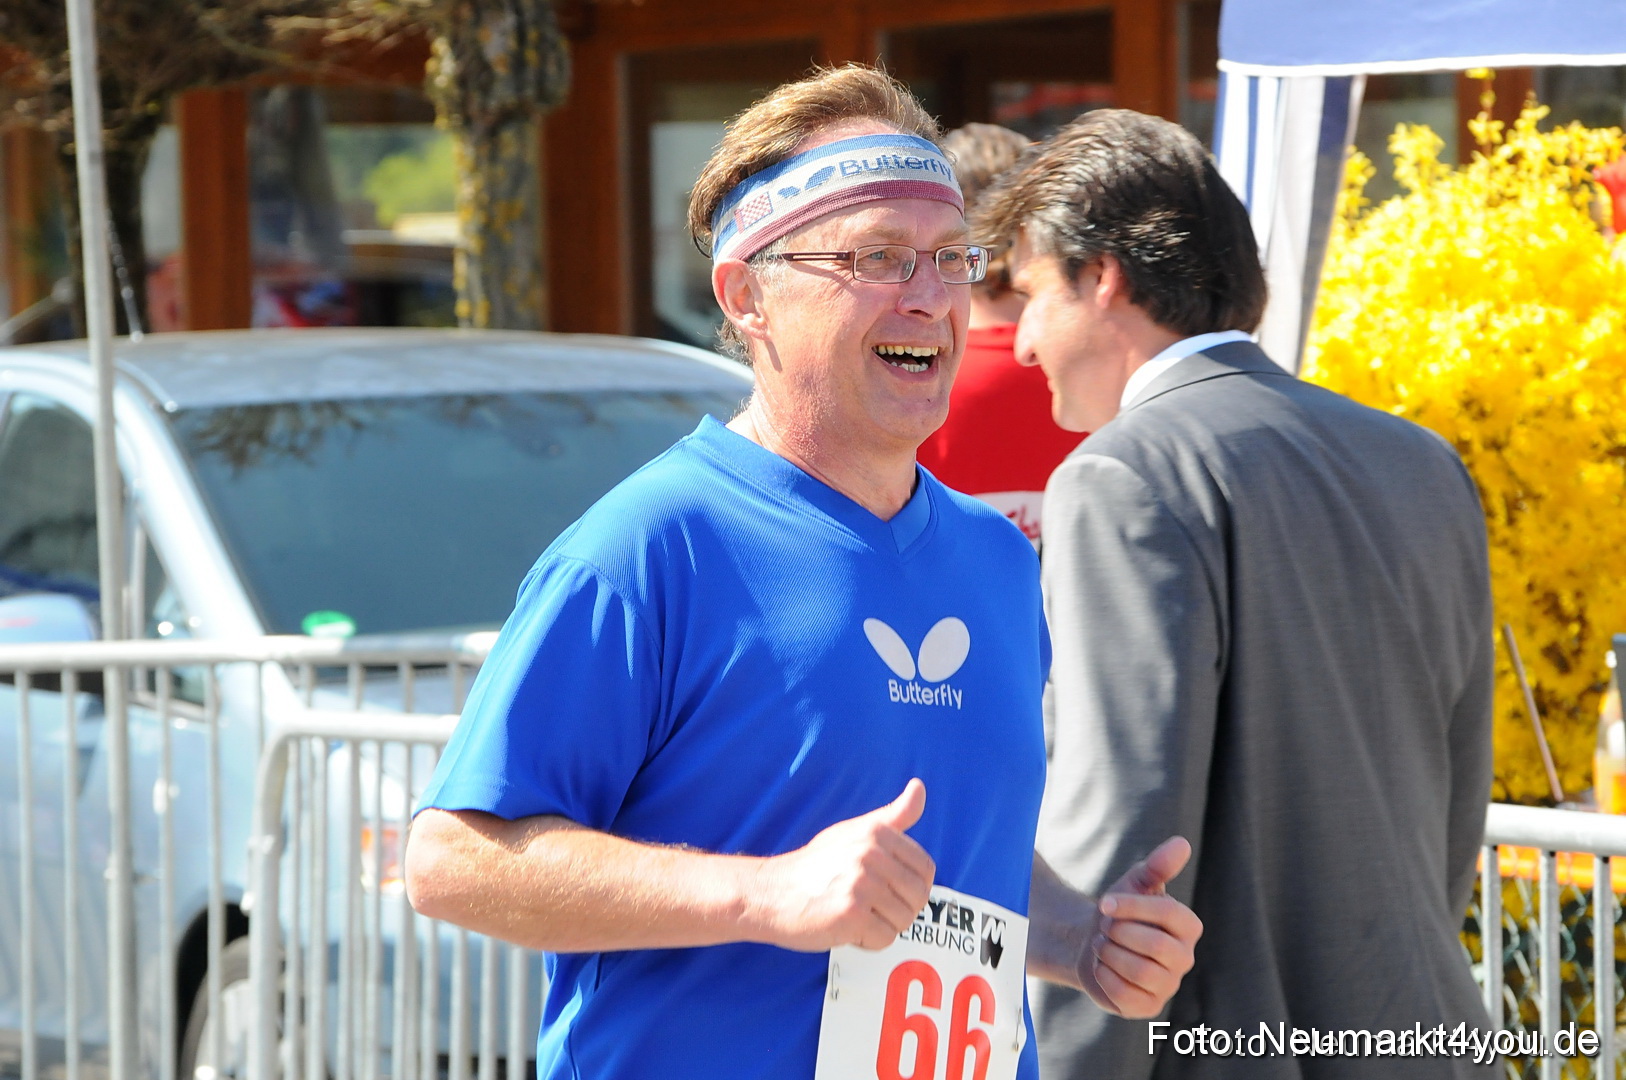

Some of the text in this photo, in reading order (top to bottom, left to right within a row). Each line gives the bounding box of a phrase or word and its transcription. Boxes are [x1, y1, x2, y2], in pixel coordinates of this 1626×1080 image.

[839, 155, 952, 181] Butterfly
[888, 678, 962, 710] Butterfly
[876, 959, 996, 1080] 66
